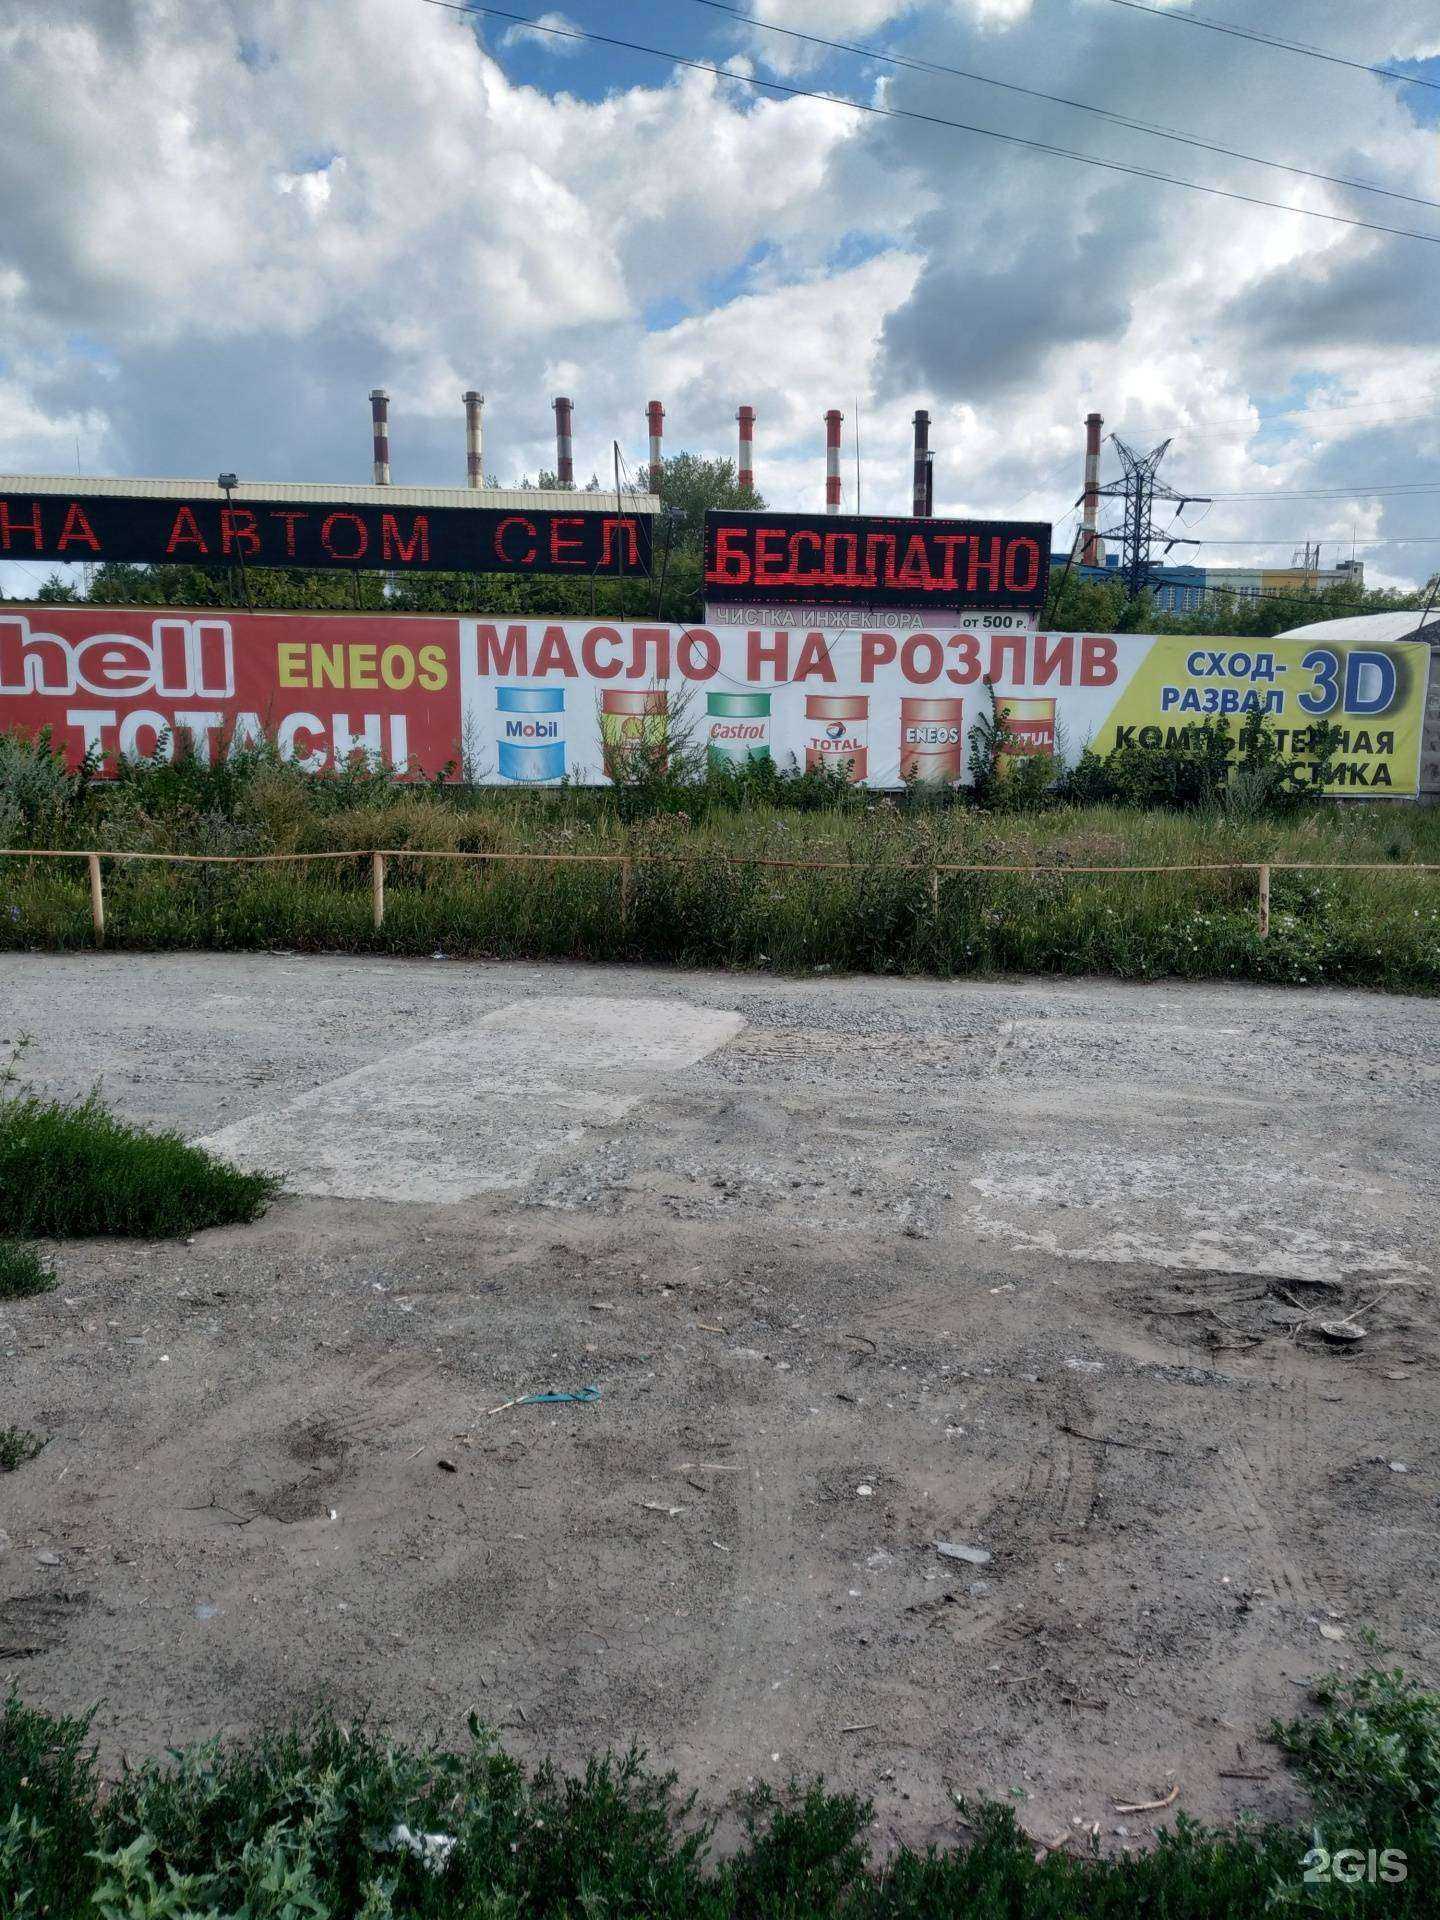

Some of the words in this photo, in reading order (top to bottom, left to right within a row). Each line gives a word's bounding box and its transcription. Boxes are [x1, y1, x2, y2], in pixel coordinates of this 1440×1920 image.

[0, 502, 103, 551] НА
[716, 607, 797, 626] ЧИСТКА
[801, 611, 925, 629] ИНЖЕКТОРА
[983, 615, 1013, 628] 500
[277, 642, 448, 691] ENEOS
[476, 623, 721, 681] МАСЛО
[747, 631, 837, 683] НА
[860, 633, 1118, 687] РОЗЛИВ
[1187, 651, 1287, 682] СХОД-
[1297, 650, 1397, 714] 3D
[66, 709, 408, 775] TOTACHI
[506, 720, 558, 738] Mobil
[710, 723, 765, 739] Castrol
[906, 727, 959, 744] ENEOS
[810, 738, 862, 750] TOTAL
